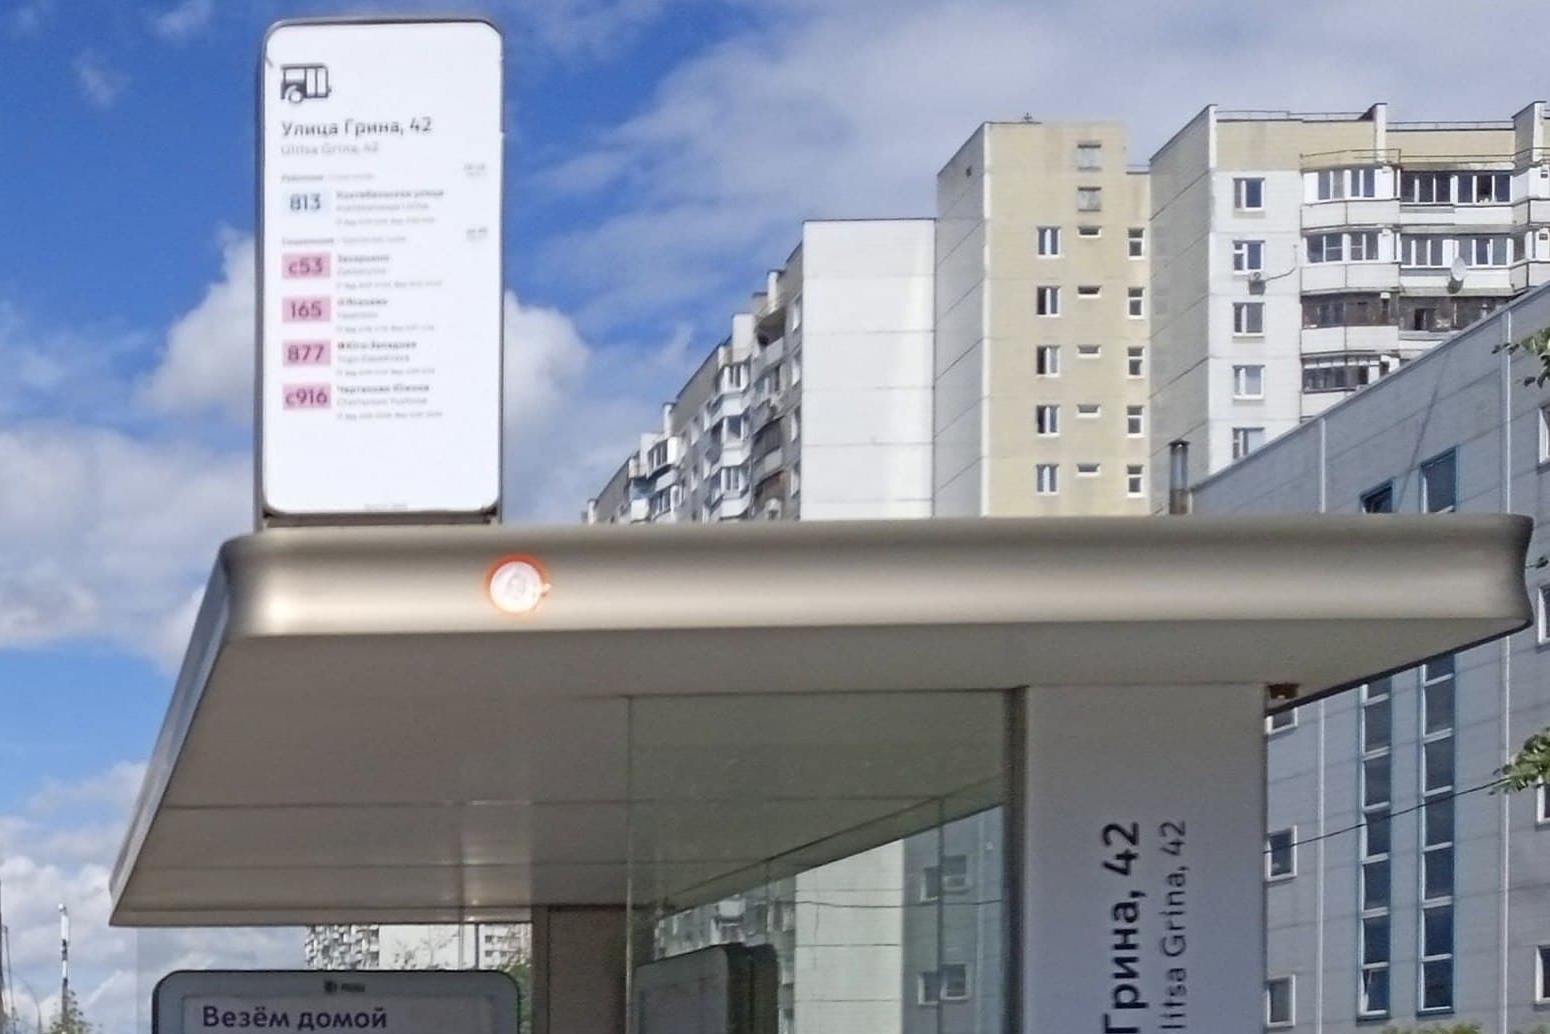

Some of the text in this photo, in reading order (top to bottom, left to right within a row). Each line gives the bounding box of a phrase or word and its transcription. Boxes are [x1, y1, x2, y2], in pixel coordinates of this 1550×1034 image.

[282, 116, 432, 137] Улица Грина, 42
[289, 192, 322, 212] 813
[290, 301, 322, 320] 165
[287, 344, 325, 364] 877
[1102, 820, 1141, 877] 42
[1159, 819, 1188, 857] 42
[1159, 865, 1190, 958] Grina,
[203, 1006, 387, 1031] Везём домой
